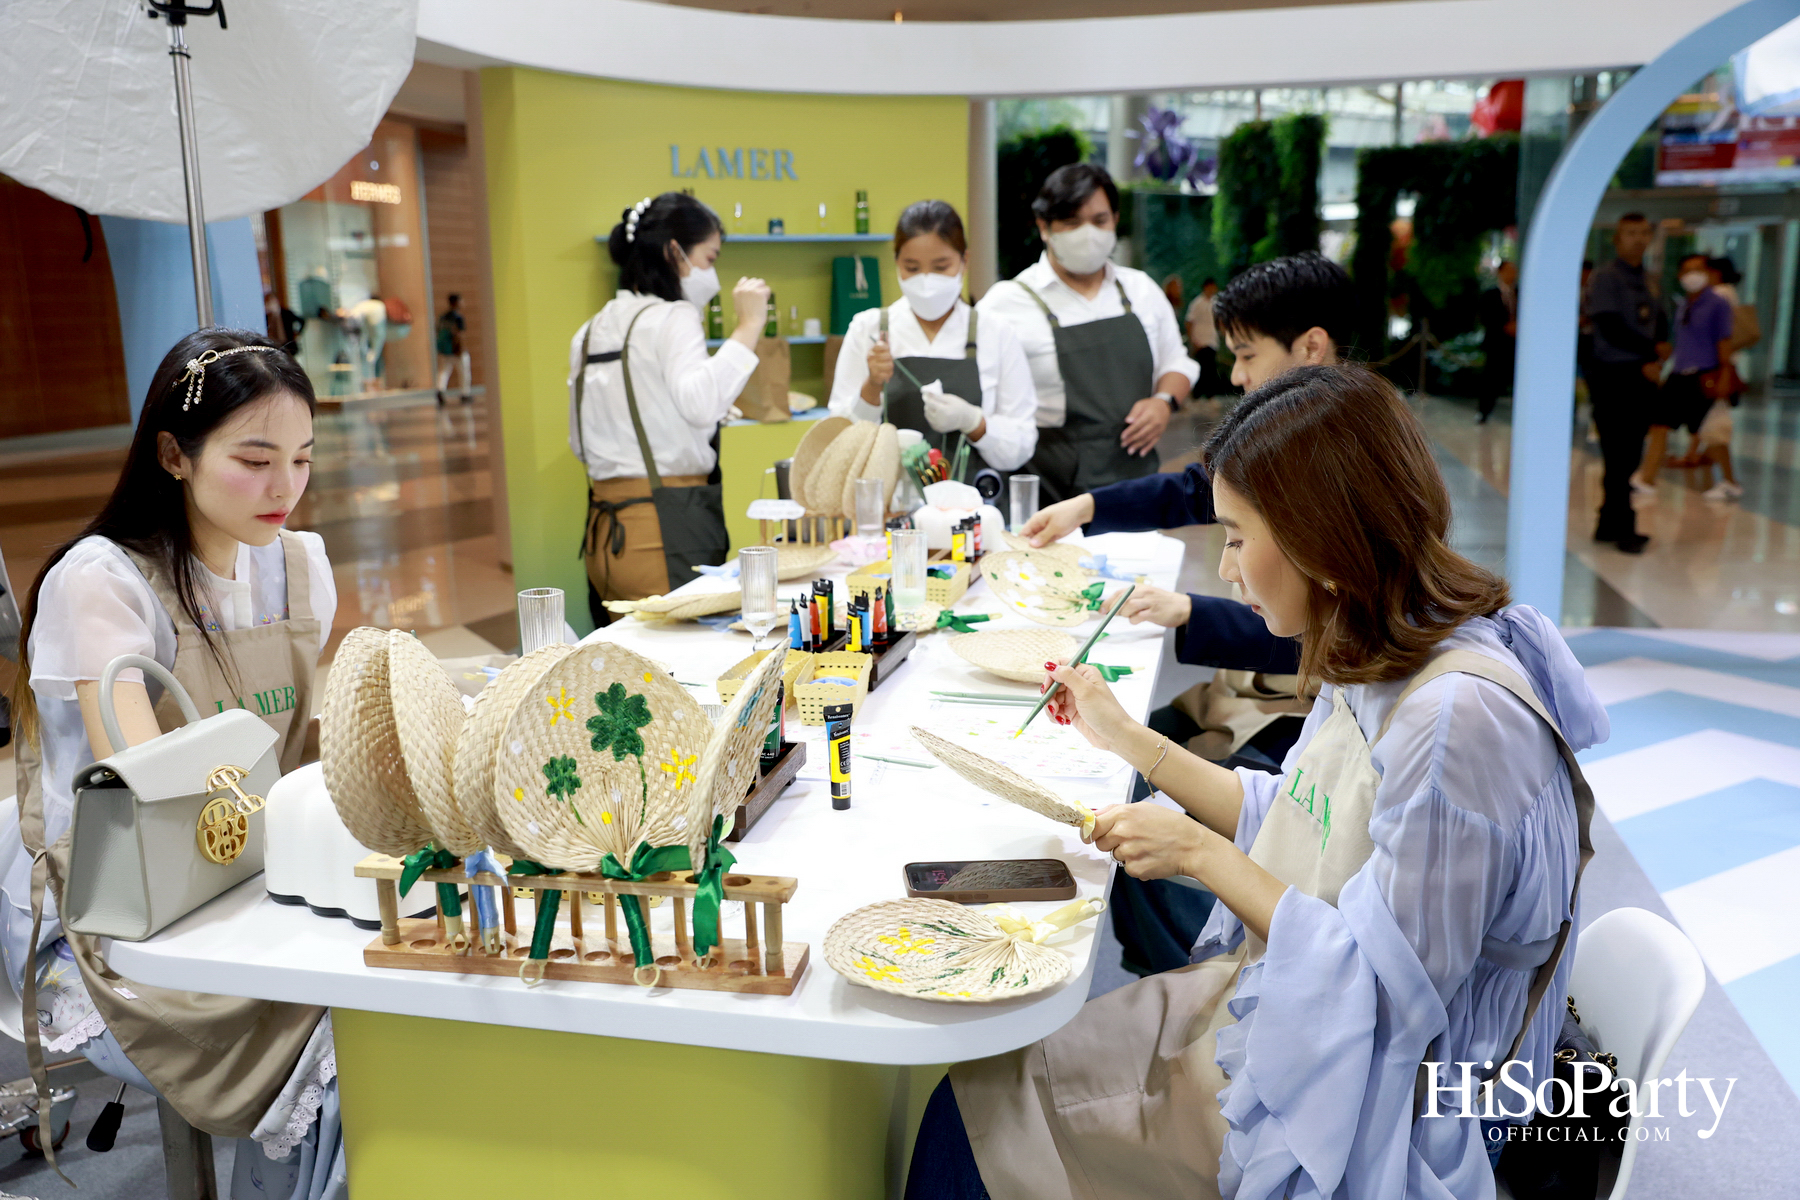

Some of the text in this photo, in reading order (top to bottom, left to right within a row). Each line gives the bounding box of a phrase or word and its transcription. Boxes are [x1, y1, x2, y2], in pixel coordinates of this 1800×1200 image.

[671, 144, 798, 180] LAMER
[252, 686, 296, 717] MER
[1287, 767, 1315, 816] LA
